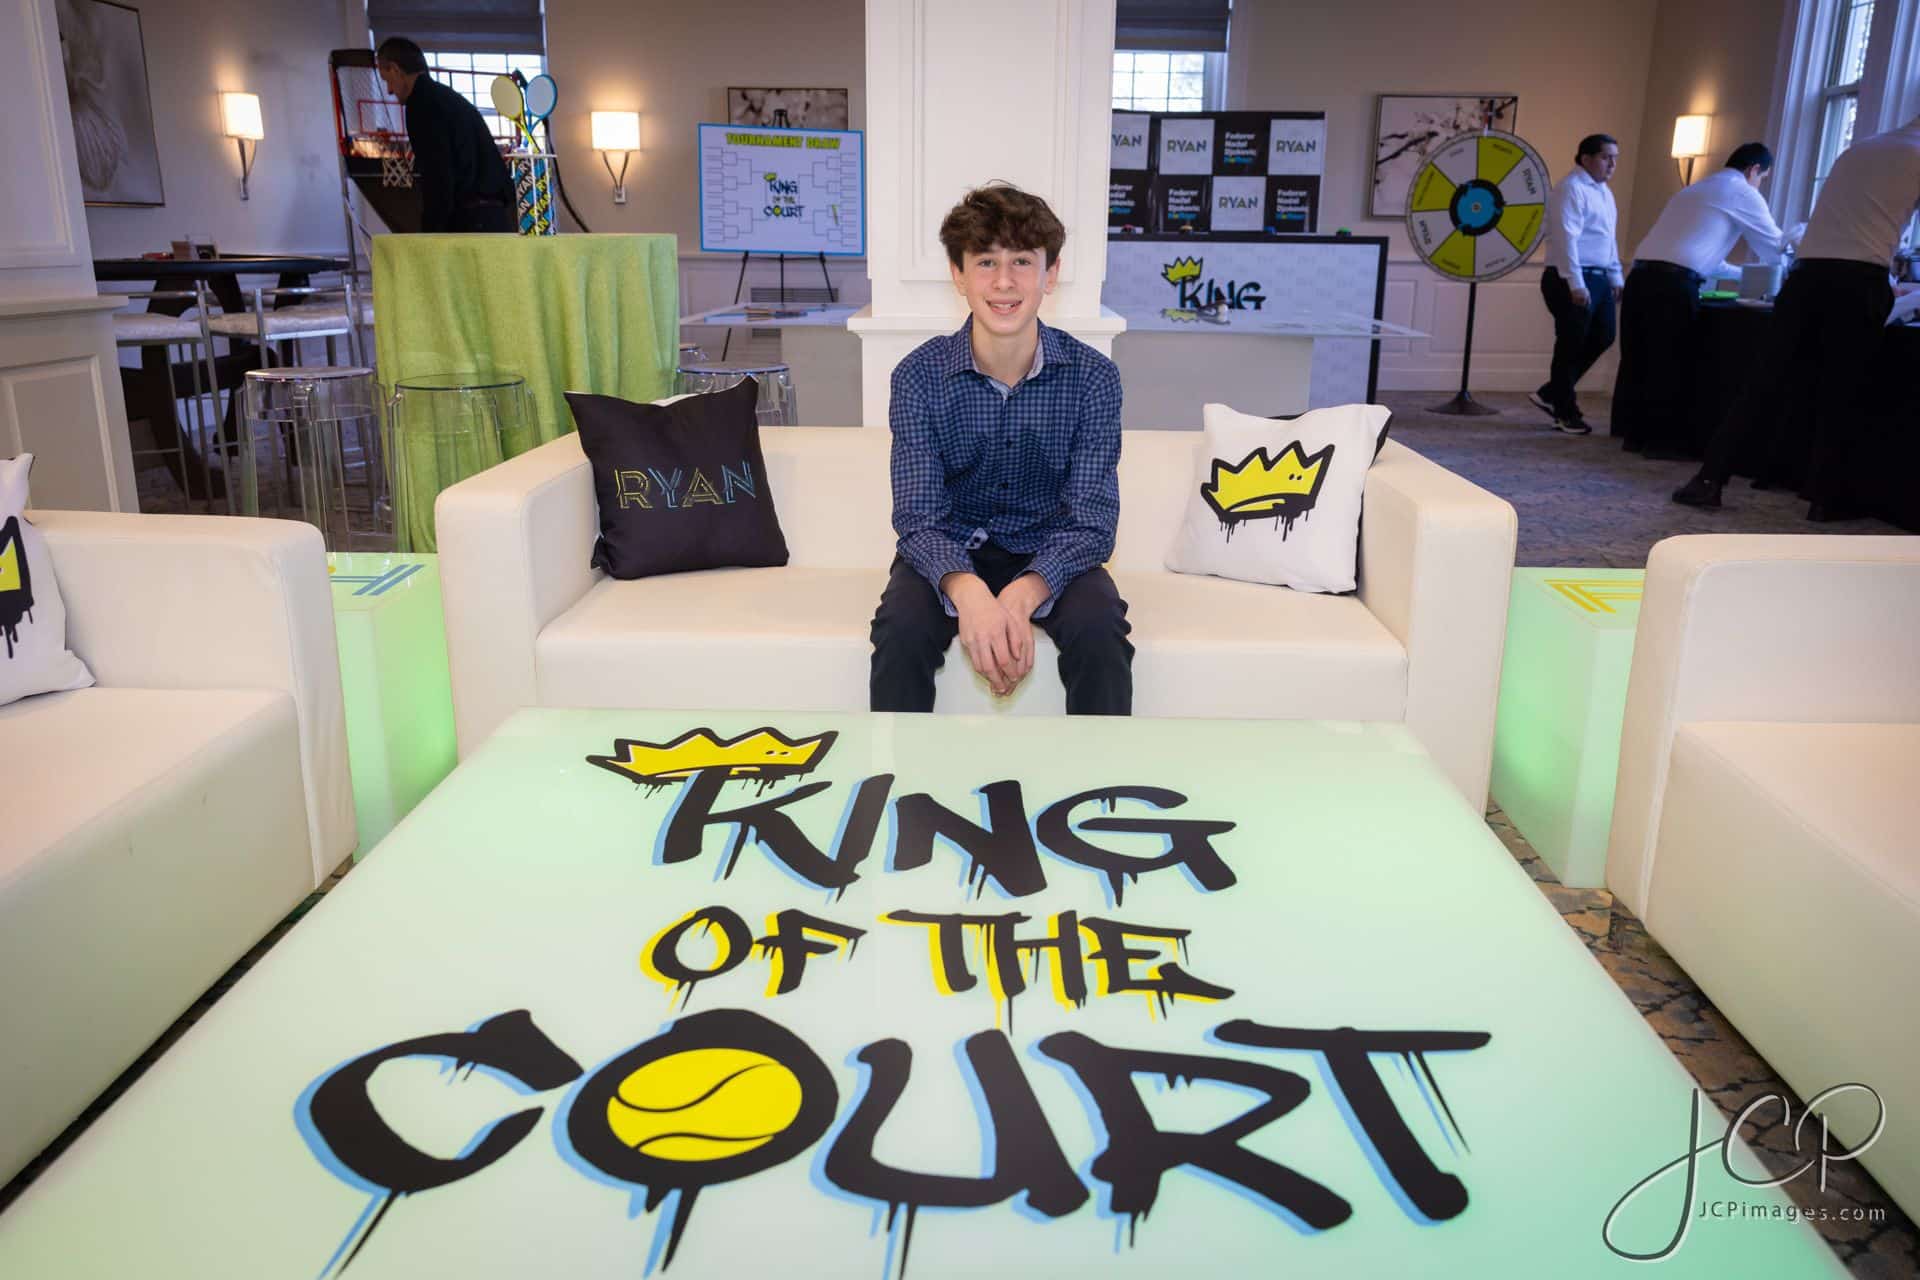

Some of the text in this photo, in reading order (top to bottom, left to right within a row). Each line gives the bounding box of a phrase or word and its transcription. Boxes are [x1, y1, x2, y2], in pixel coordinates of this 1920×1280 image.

[726, 132, 840, 150] TOURNAMENT DRAW
[1112, 134, 1142, 147] YAN
[1167, 140, 1207, 153] RYAN
[1276, 140, 1316, 153] RYAN
[769, 179, 798, 195] KING
[763, 205, 806, 218] COURT
[1219, 197, 1258, 209] RYAN
[1179, 277, 1267, 311] KING
[614, 460, 757, 509] RYAN
[651, 768, 1238, 907] KING
[640, 905, 1236, 1034] OF THE
[294, 1008, 1492, 1279] COURT
